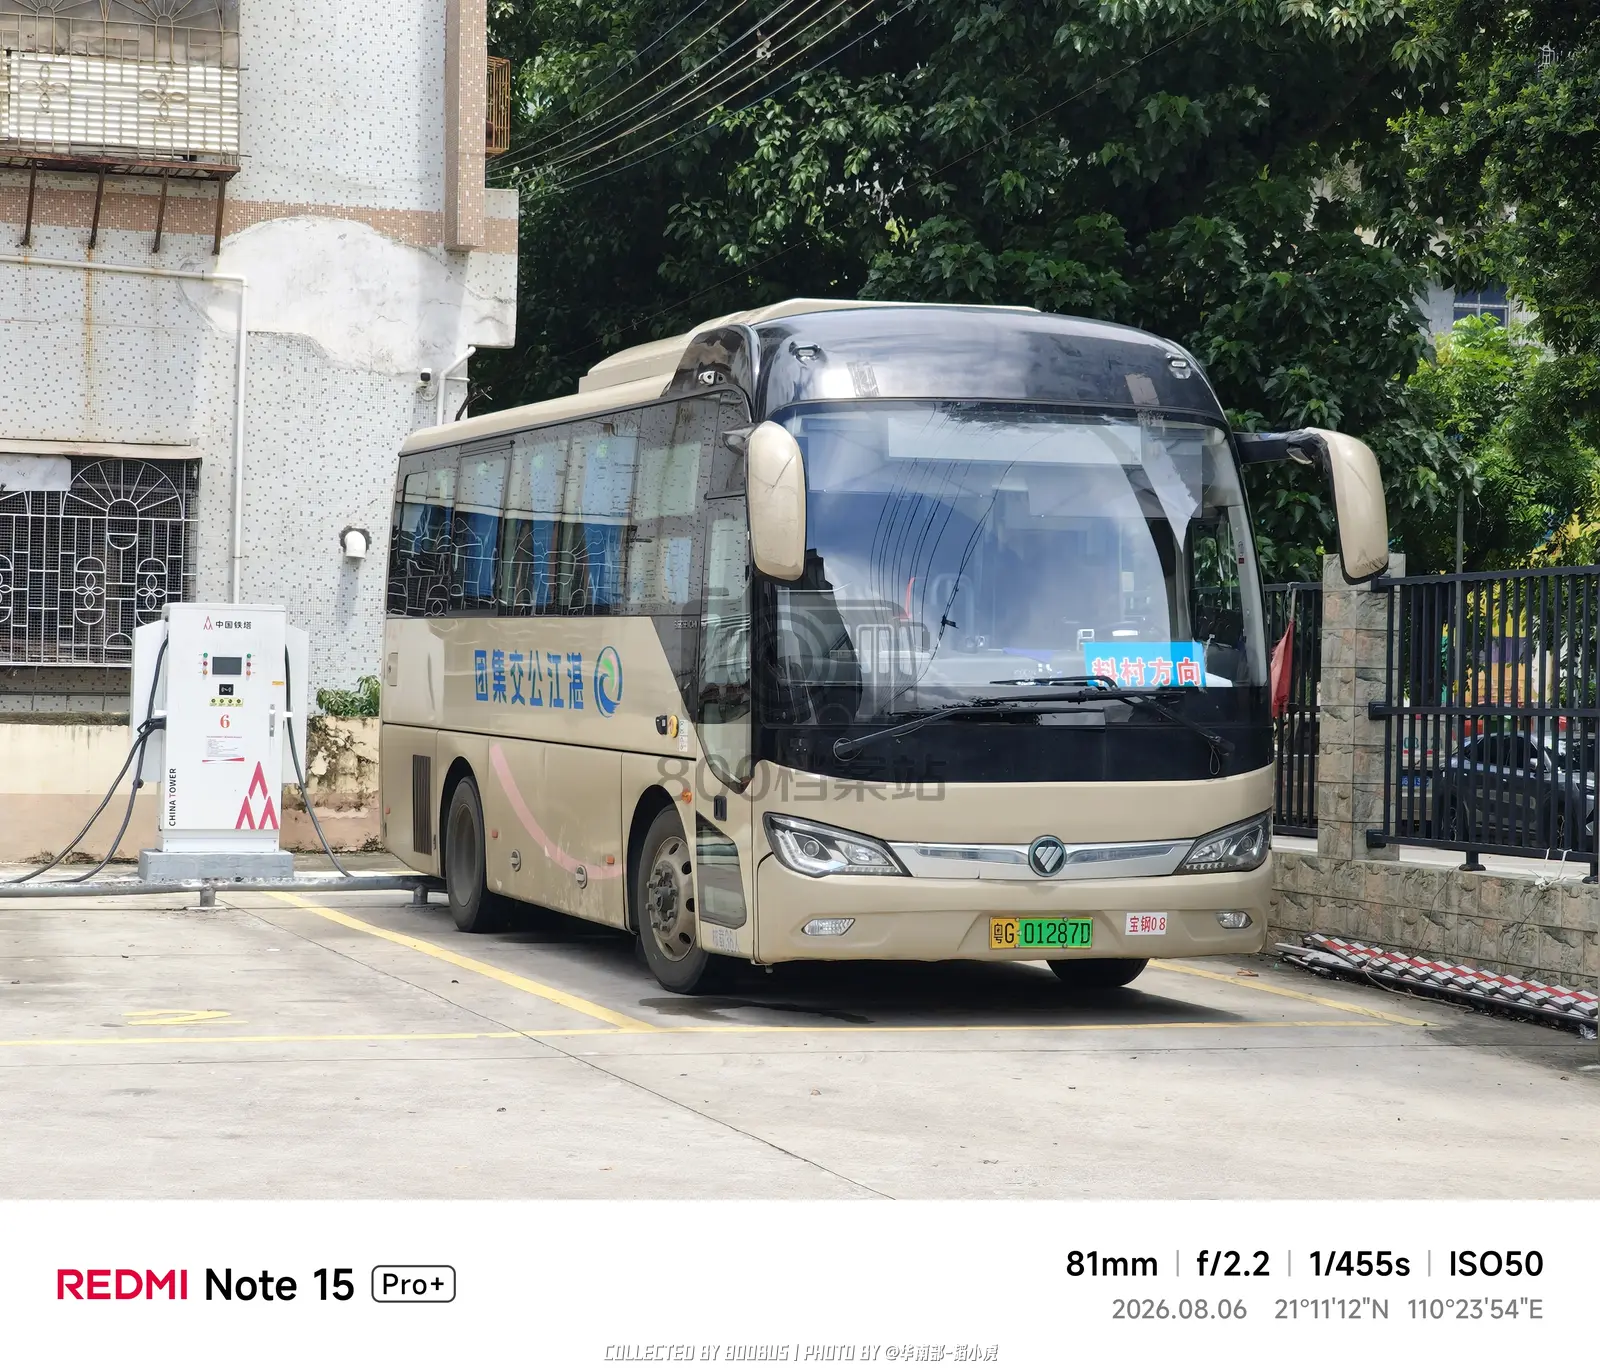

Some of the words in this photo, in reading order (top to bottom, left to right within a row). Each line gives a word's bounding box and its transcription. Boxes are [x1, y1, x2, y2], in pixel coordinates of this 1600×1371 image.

[215, 620, 252, 630] 中国铁塔
[220, 714, 230, 729] 6
[168, 768, 177, 798] TOWER
[168, 799, 177, 827] CHINA
[1024, 922, 1091, 944] 01287D
